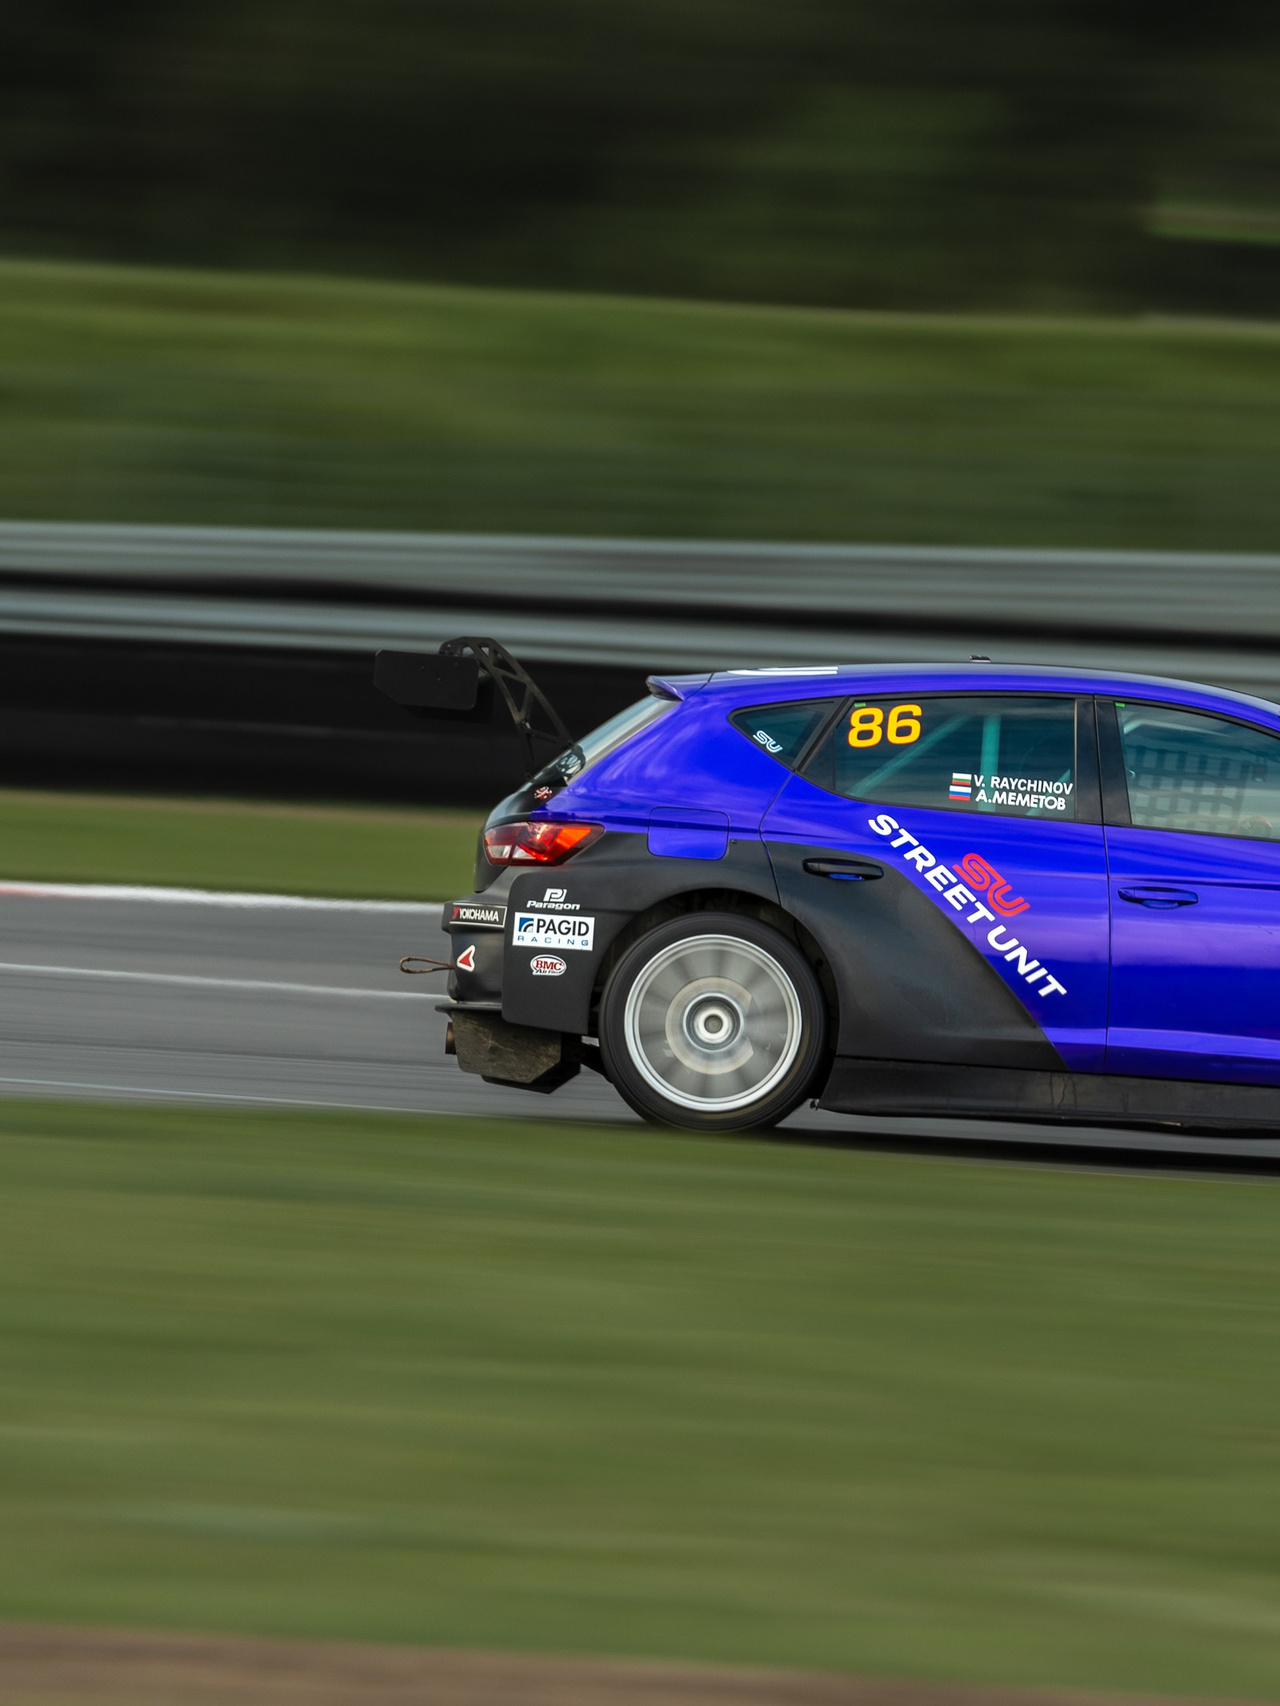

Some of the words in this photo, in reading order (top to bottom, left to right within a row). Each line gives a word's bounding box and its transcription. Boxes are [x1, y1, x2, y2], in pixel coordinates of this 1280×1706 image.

[847, 703, 923, 748] 86
[752, 730, 783, 753] SU
[973, 774, 986, 788] V.
[990, 776, 1074, 795] RAYCHINOV
[975, 789, 1066, 811] A.MEMETOB
[952, 852, 1030, 918] SU
[459, 908, 499, 922] YOKOHAMA
[526, 900, 581, 910] Paragon
[868, 813, 995, 924] STREET
[987, 924, 1067, 998] UNIT
[536, 918, 590, 937] PAGID
[517, 935, 589, 947] RACING
[535, 960, 562, 971] BMC
